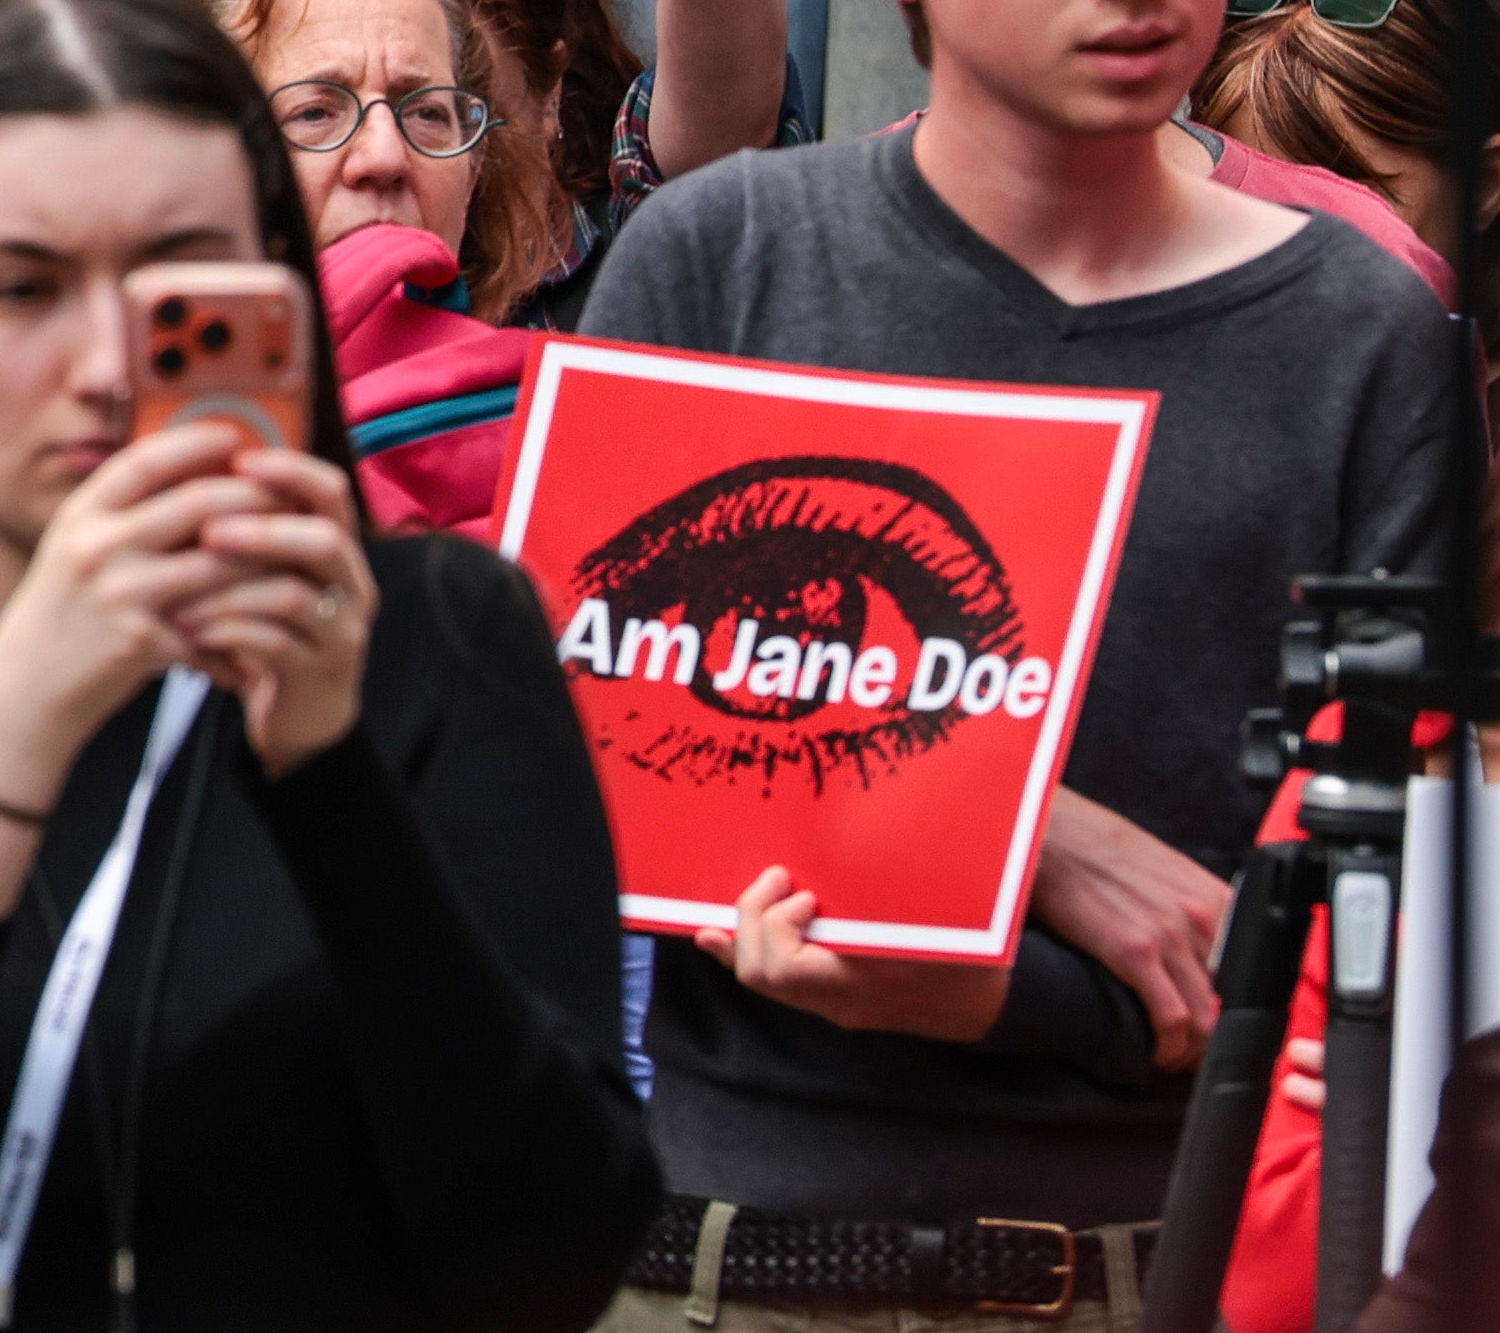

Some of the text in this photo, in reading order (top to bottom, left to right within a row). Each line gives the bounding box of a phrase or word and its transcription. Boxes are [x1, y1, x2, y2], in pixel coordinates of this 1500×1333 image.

[555, 598, 1054, 720] Am Jane Doe
